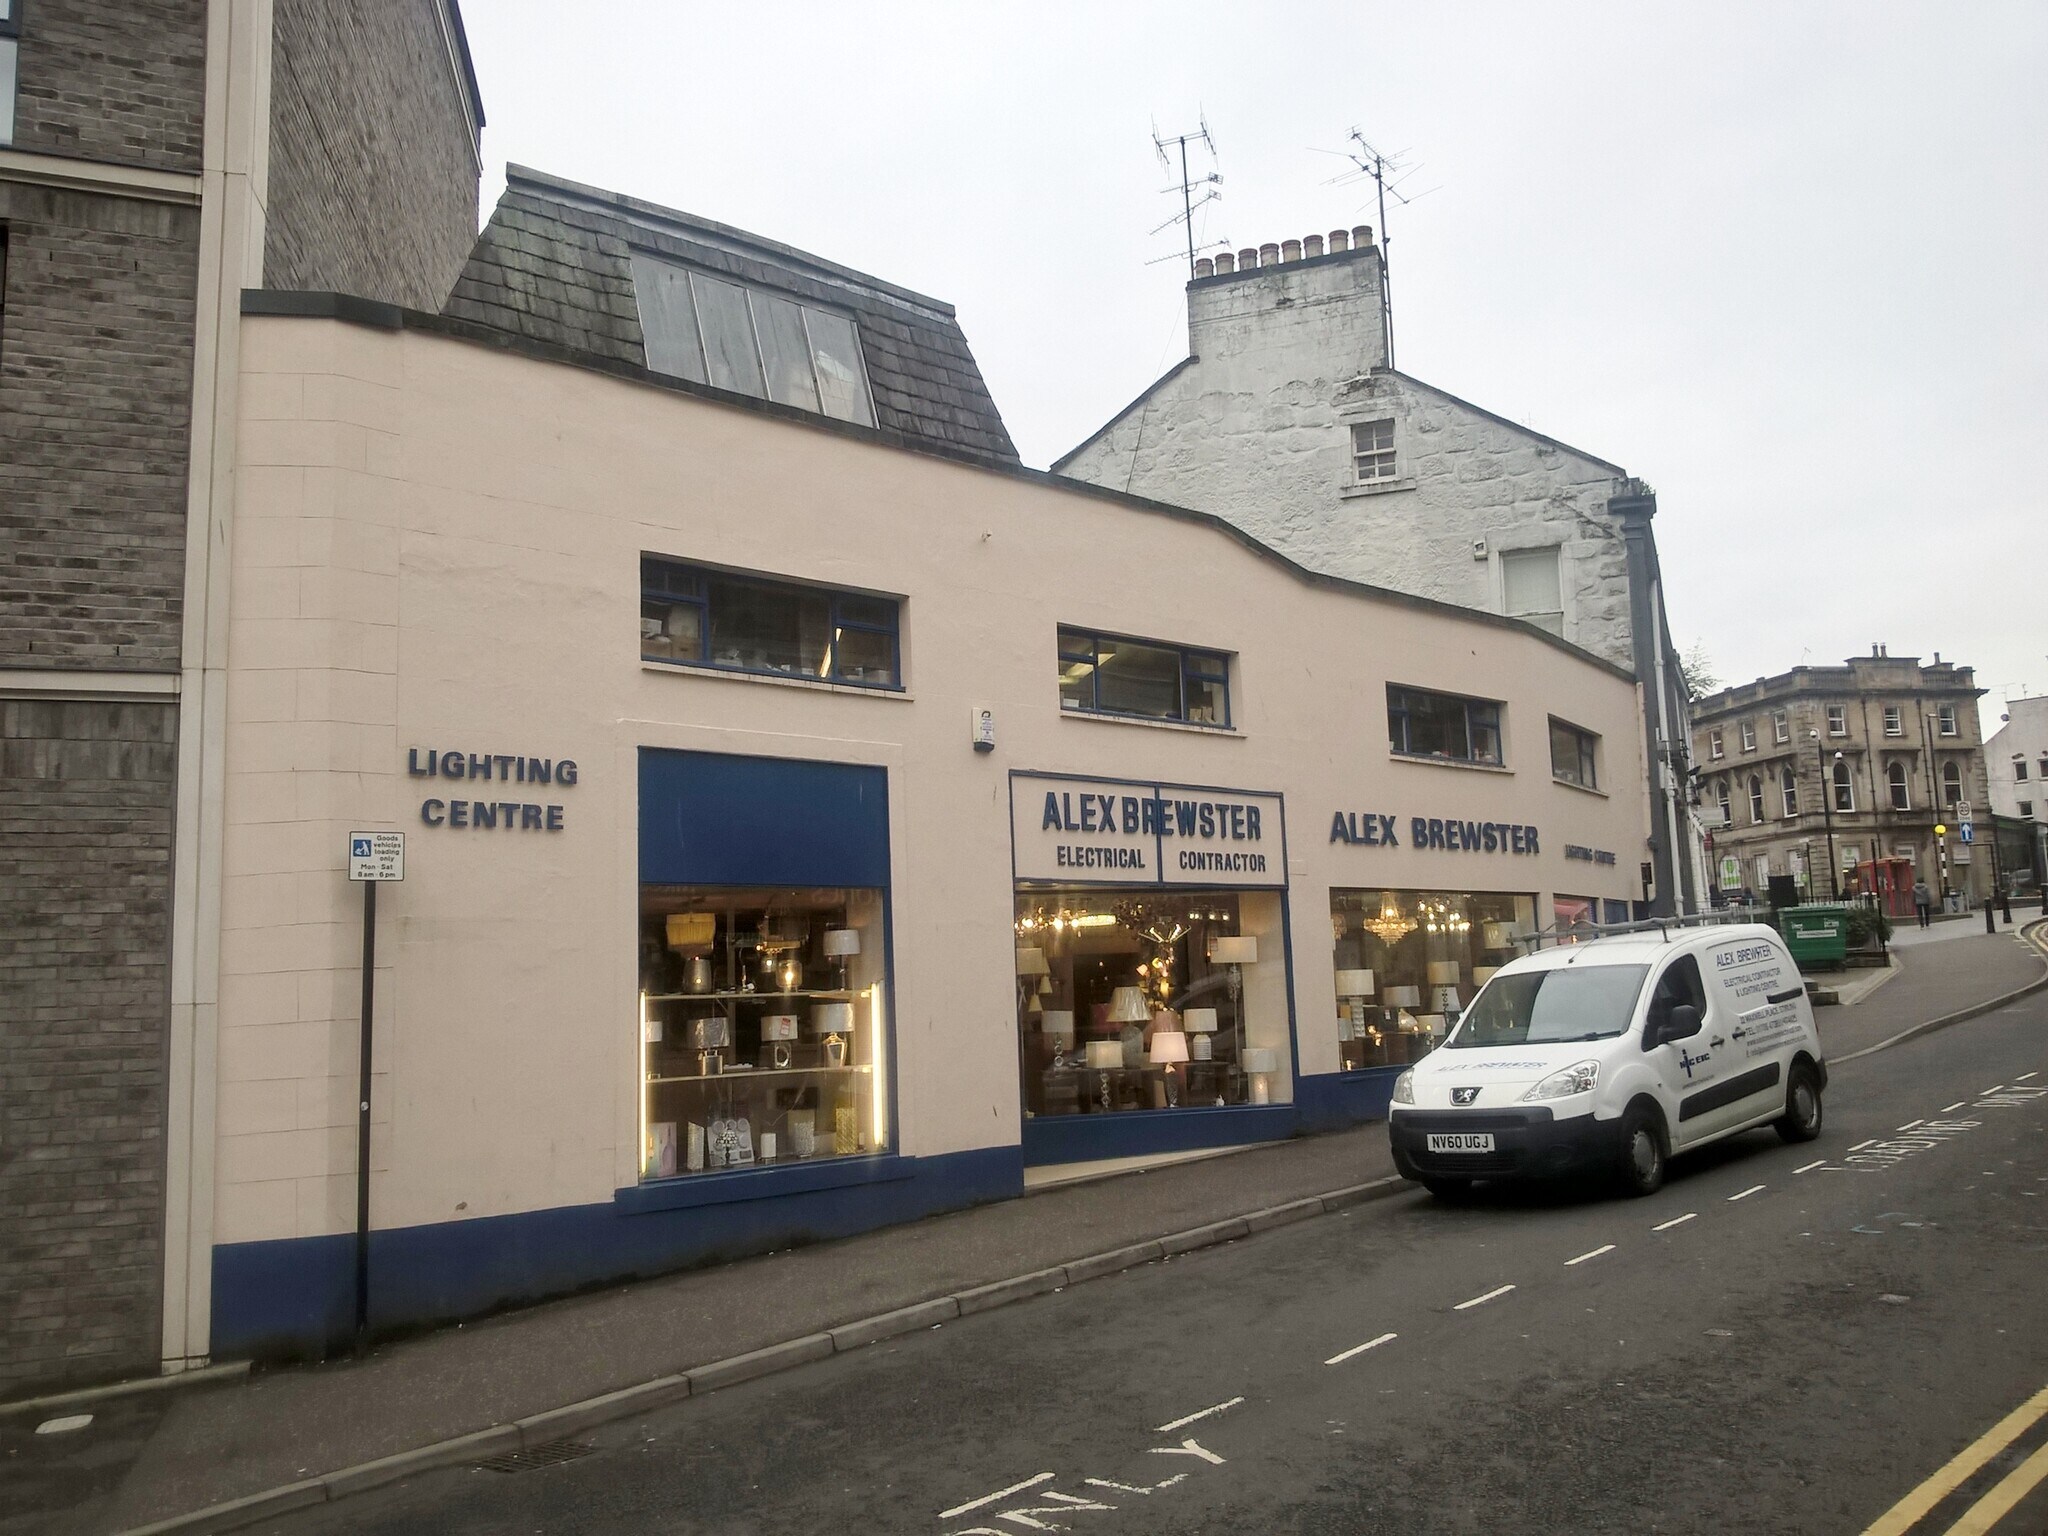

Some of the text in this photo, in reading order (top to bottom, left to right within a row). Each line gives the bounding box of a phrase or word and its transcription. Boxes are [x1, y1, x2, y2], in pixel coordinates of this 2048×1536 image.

[409, 748, 578, 785] LIGHTING
[421, 798, 564, 830] CENTRE
[1042, 791, 1261, 841] ALEX BREWSTER
[1330, 811, 1541, 855] ALEX BREWSTER
[374, 848, 400, 856] loading
[1056, 844, 1267, 872] ELECTRICAL CONTRACTOR
[1716, 951, 1736, 967] ALEX
[1723, 966, 1781, 988] ELECTRICAL CONTRACTOR
[1431, 1135, 1489, 1149] NV60 UGJ
